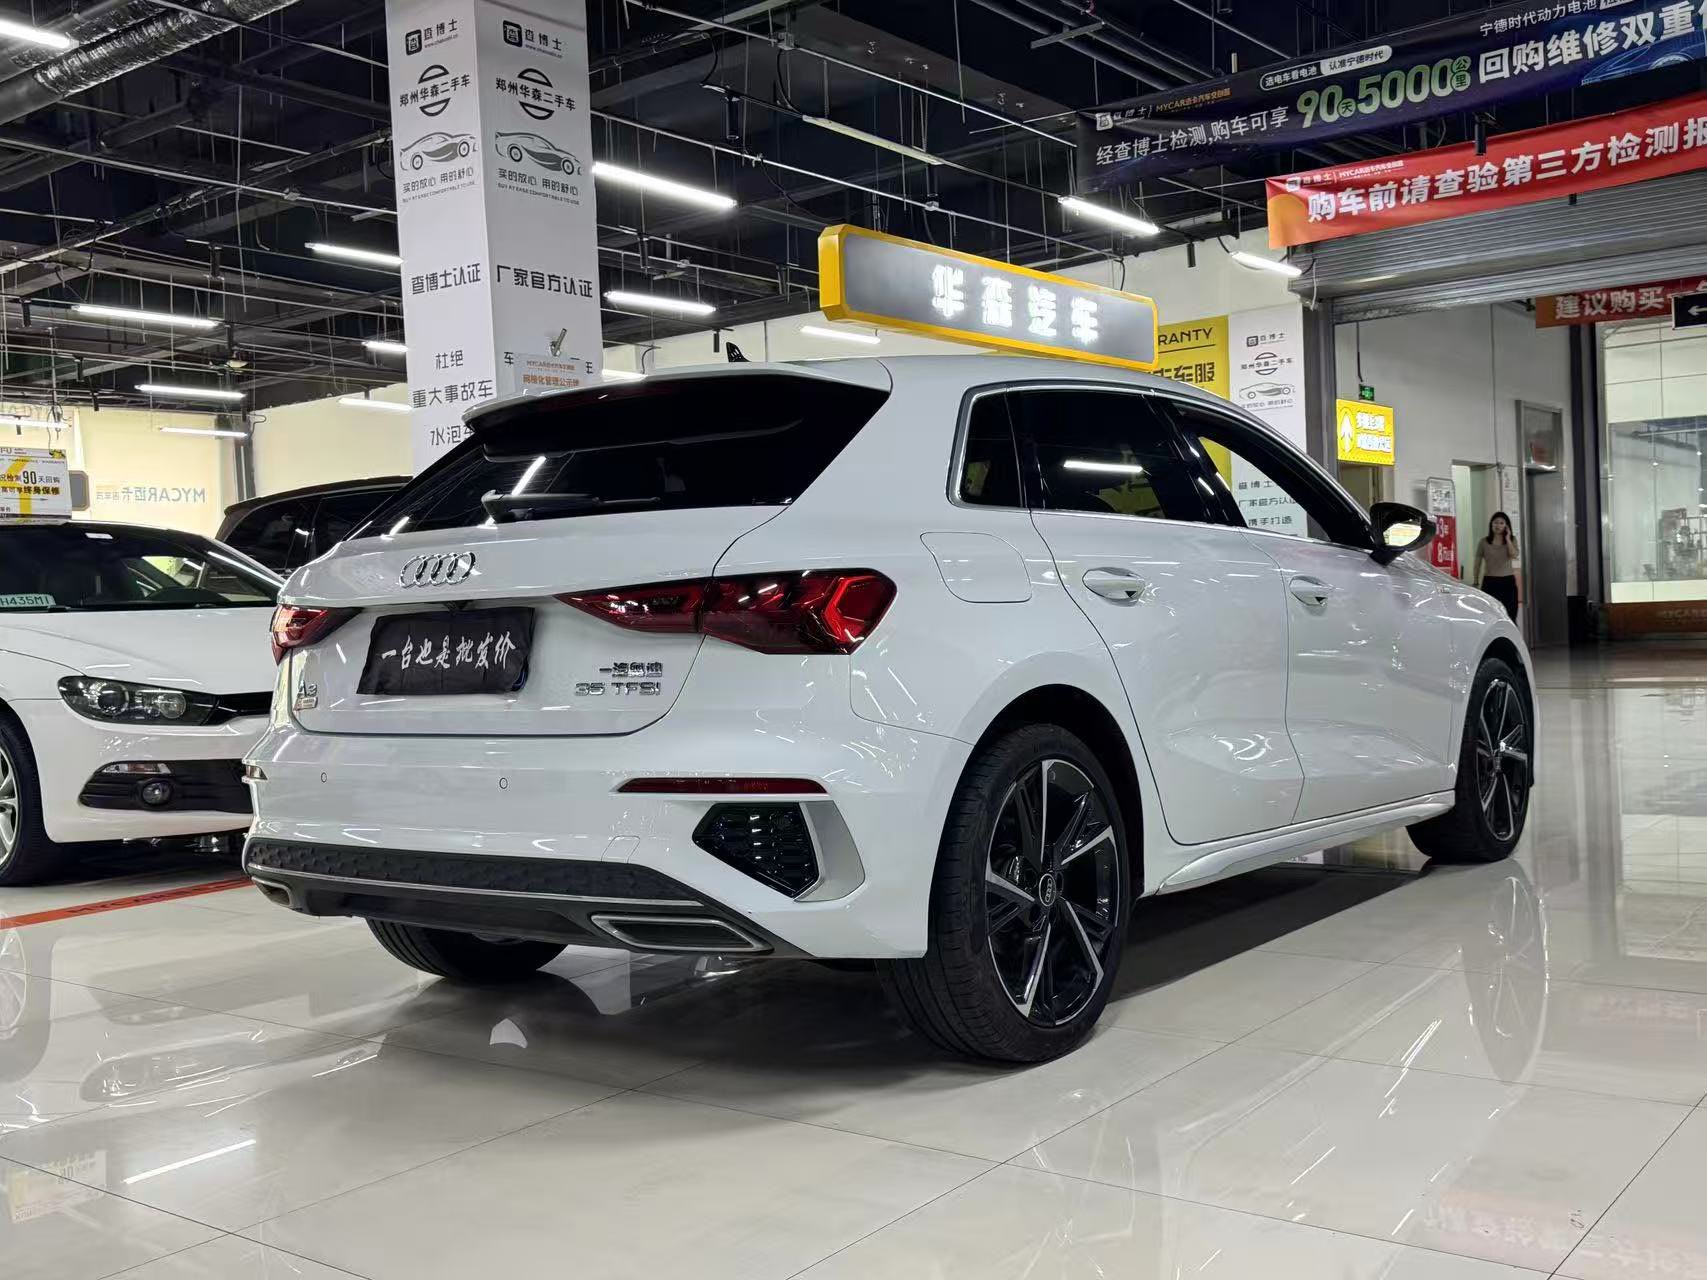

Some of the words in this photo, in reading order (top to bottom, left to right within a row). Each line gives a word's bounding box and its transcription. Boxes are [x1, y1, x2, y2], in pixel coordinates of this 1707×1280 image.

[1478, 0, 1707, 84] 回购维修双重
[399, 74, 471, 107] 郑州华森二手车
[496, 77, 576, 111] 郑州华森二手车
[498, 168, 537, 186] 买的放心
[542, 178, 579, 196] 用的舒心
[411, 263, 481, 295] 查博士认证
[496, 265, 593, 298] 厂家官方认证
[435, 350, 464, 370] 杜绝
[413, 379, 494, 409] 重大事故车
[382, 631, 516, 670] 一台也是批发价
[575, 682, 605, 696] 35
[611, 682, 661, 696] TFSI
